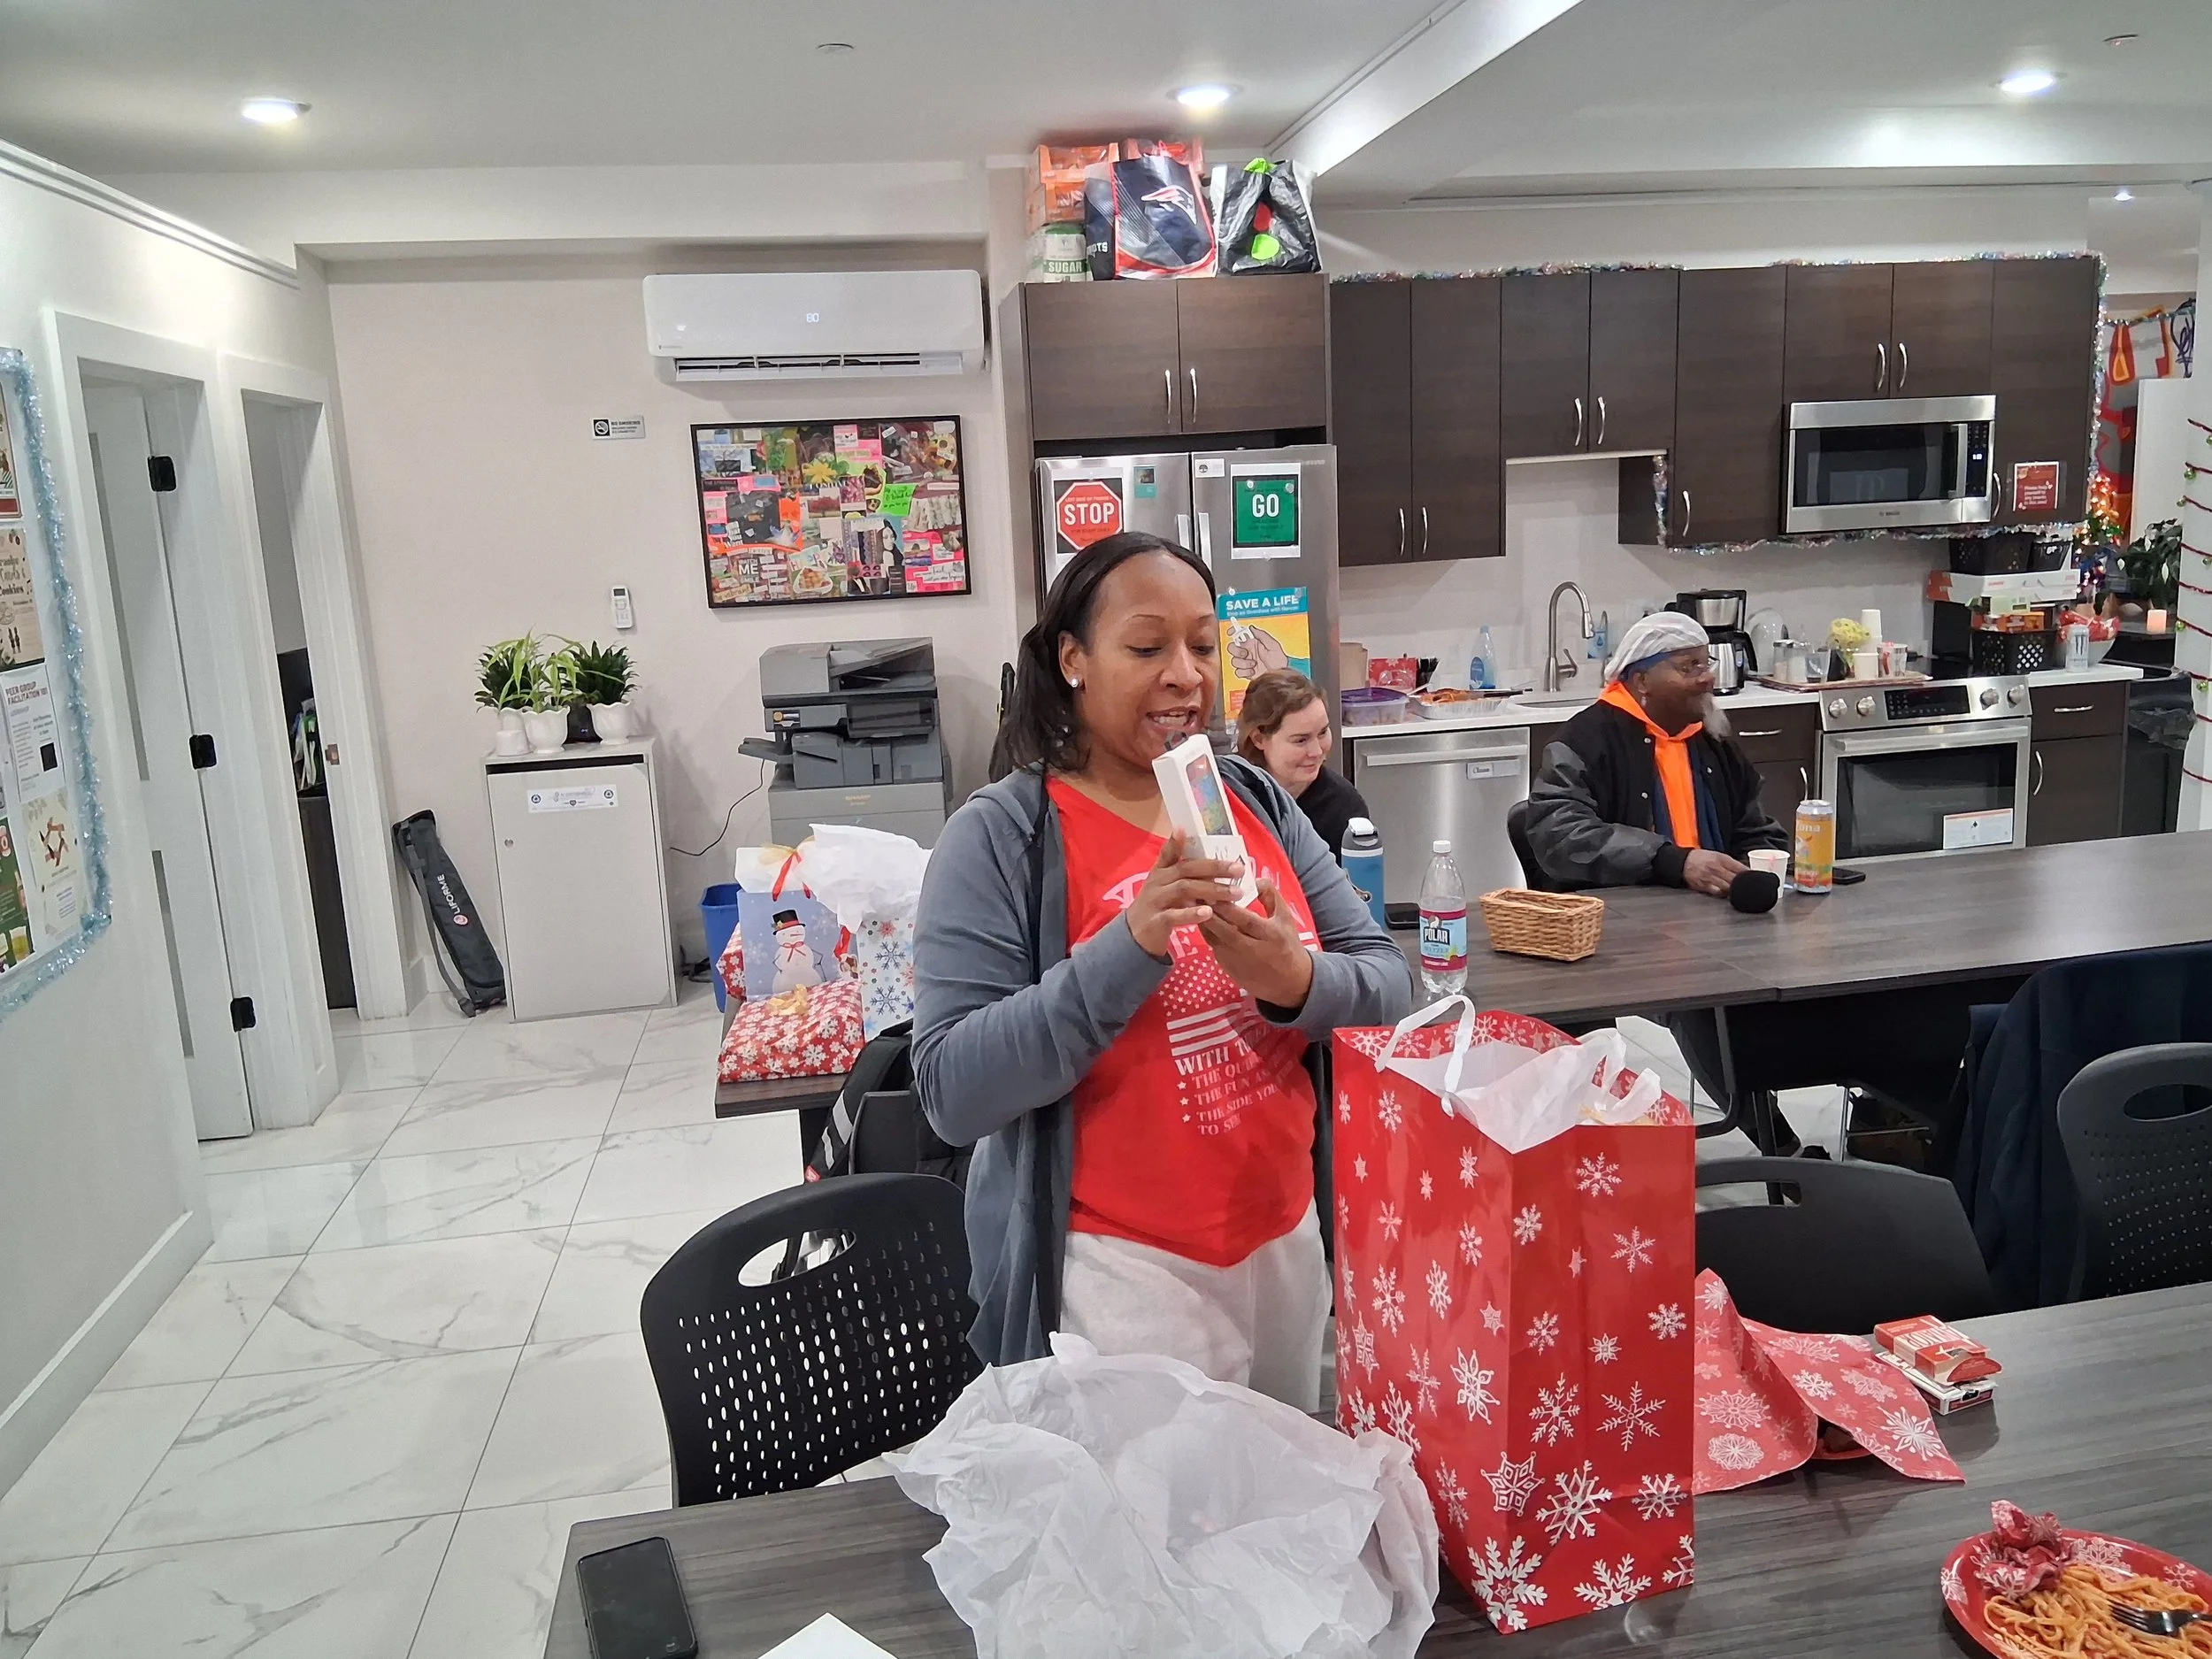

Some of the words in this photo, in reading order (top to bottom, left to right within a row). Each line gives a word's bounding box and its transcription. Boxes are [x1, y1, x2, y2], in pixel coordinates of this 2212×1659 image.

[1048, 261, 1083, 273] SUGAR
[1064, 502, 1115, 526] STOP
[1252, 493, 1279, 518] GO
[738, 563, 759, 575] ME
[1225, 598, 1259, 611] SAVE
[1262, 597, 1271, 607] A
[1273, 595, 1300, 606] LIFE
[5, 686, 19, 696] PEER
[19, 681, 36, 693] GROUP
[7, 690, 41, 705] FACILITATION
[437, 873, 461, 915] LIFORME
[1424, 927, 1448, 944] POLAR
[1175, 1047, 1230, 1076] WITH
[1192, 1068, 1222, 1089] THE
[1194, 1087, 1223, 1106] THE
[1196, 1108, 1225, 1122] THE
[1225, 1094, 1254, 1111] SIDE
[1256, 1082, 1279, 1102] YOU
[1197, 1124, 1219, 1136] TO
